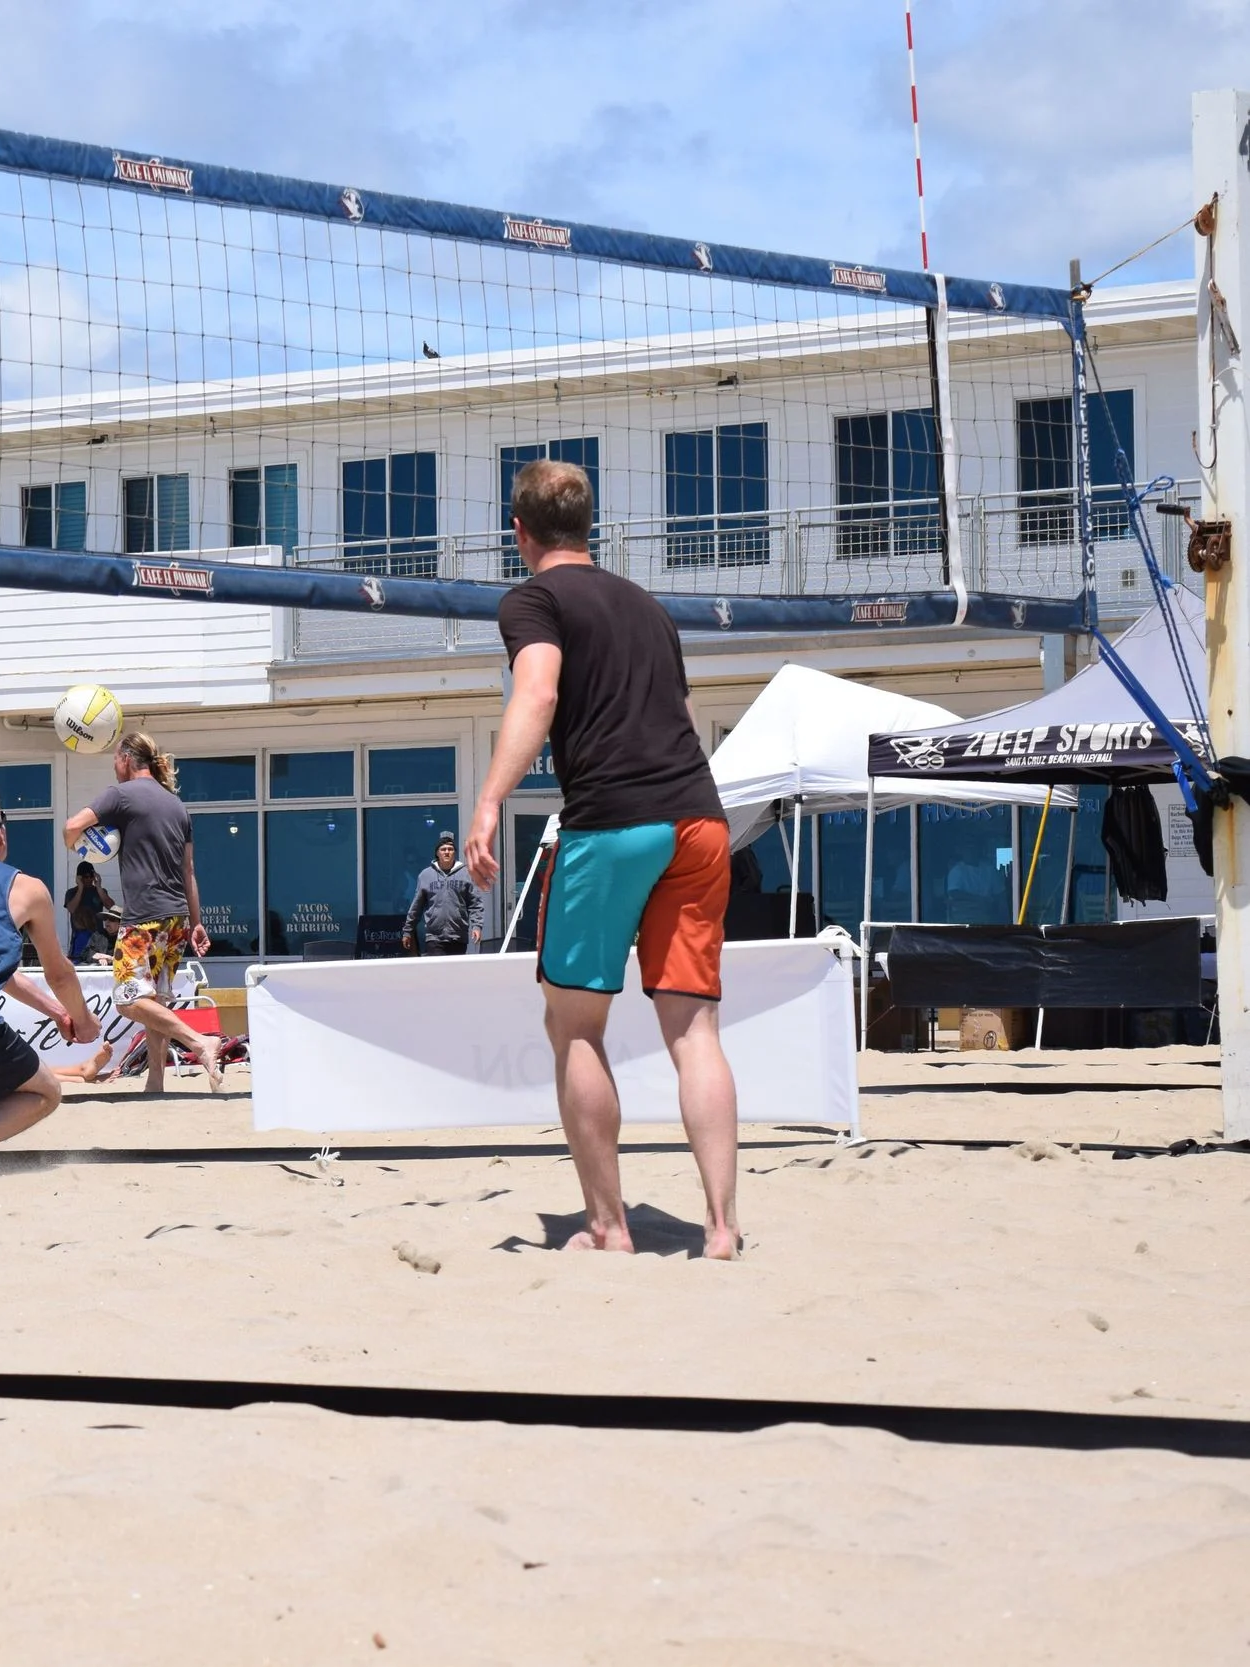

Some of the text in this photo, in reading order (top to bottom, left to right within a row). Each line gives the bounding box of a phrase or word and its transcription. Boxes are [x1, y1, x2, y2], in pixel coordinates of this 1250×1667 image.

[140, 568, 207, 588] CAFE EL PALOMAR
[66, 717, 94, 741] Wilson
[962, 721, 1156, 757] 2DEEP SPORTS
[1005, 753, 1113, 767] SANTA CRUZ BEACH VOLLEYBALL
[296, 903, 329, 913] TACOS
[202, 915, 230, 924] BEER
[291, 912, 333, 922] NACHOS
[205, 924, 249, 934] GARITAS
[286, 922, 340, 933] BURRITOS
